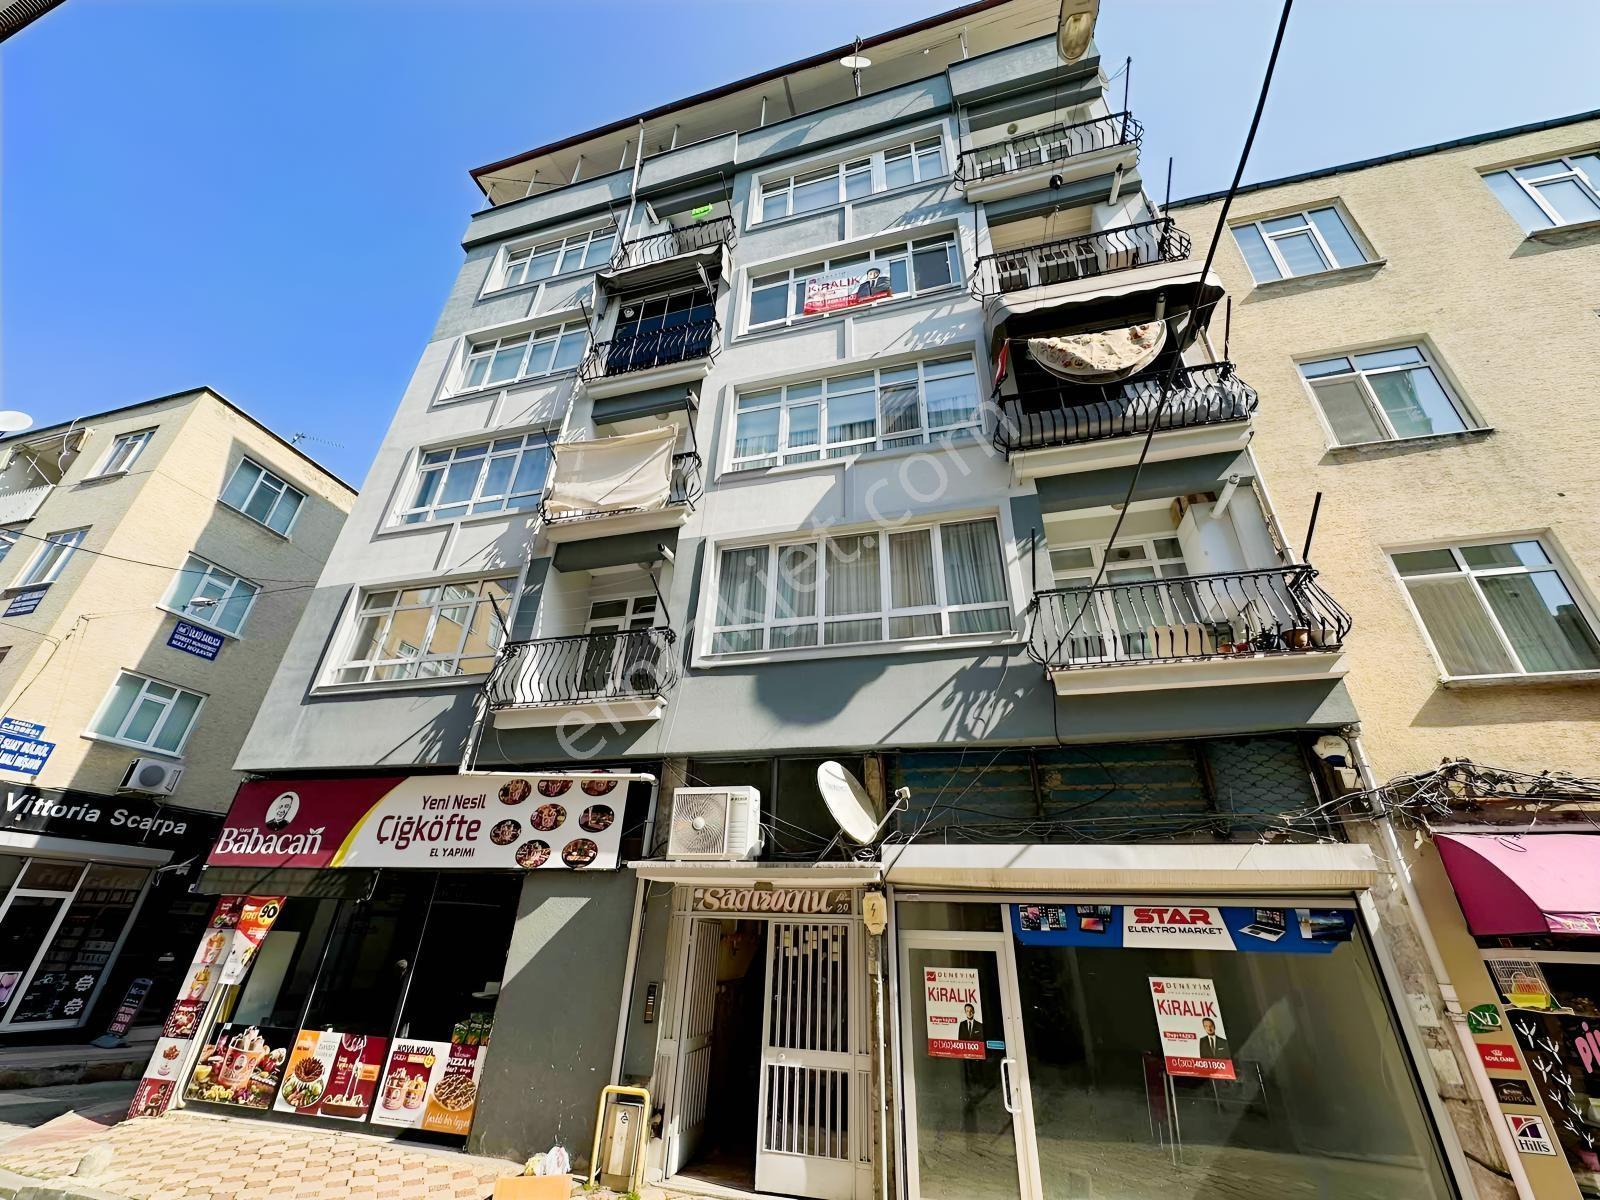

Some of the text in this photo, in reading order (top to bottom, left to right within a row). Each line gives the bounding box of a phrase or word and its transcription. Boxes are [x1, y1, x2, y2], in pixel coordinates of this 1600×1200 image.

[422, 794, 487, 810] Yeni Nesil
[6, 792, 187, 836] Vittoria Scarpa
[376, 813, 482, 850] Çiğköfte
[429, 848, 475, 857] EL YAPIMI
[259, 905, 278, 919] 90
[1133, 908, 1213, 925] STAR
[1127, 925, 1223, 935] ELEKTRO MARKET
[1520, 1139, 1550, 1153] Hill's
